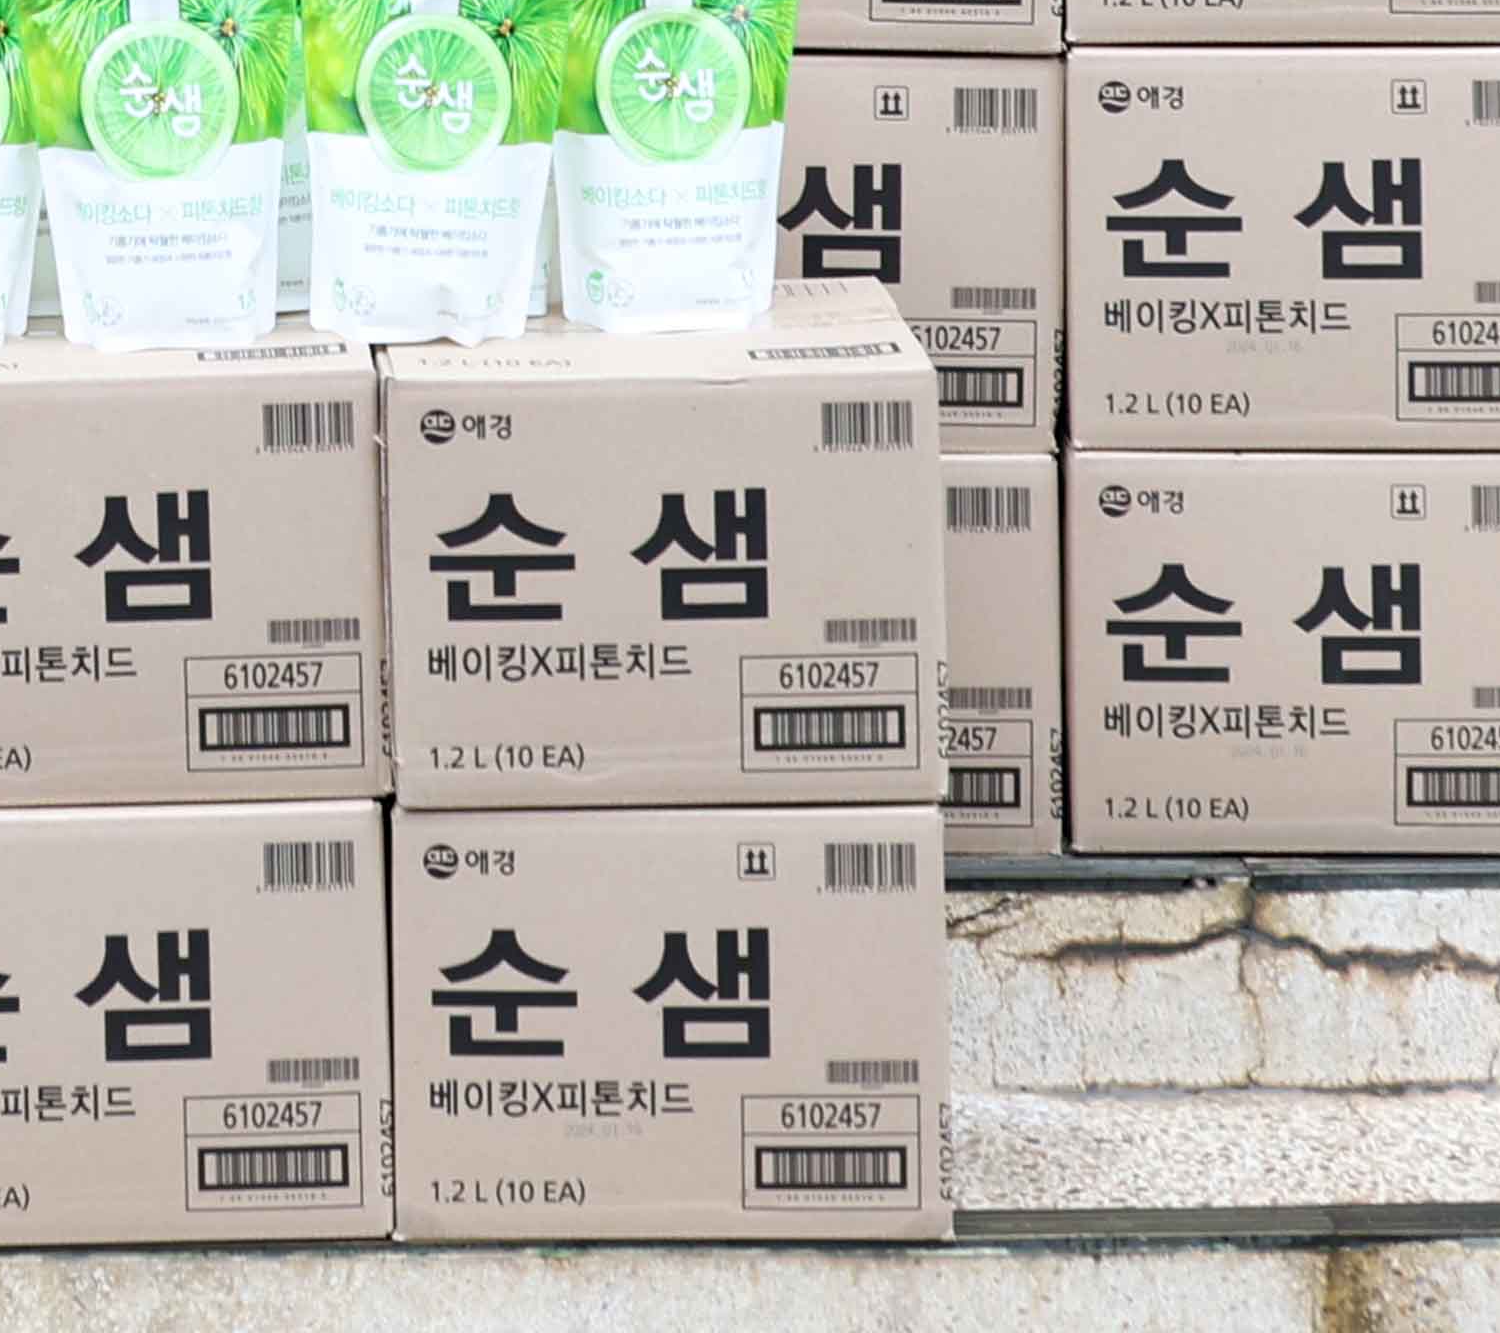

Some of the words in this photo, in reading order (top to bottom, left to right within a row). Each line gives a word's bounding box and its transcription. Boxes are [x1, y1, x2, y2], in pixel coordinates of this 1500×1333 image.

[1137, 83, 1186, 112] 애경
[1104, 296, 1352, 337] 베이킹X피톤치드
[462, 410, 514, 443] 애경
[428, 638, 693, 687] 베이킹X피톤치드
[1104, 701, 1350, 742] 베이킹X피톤치드
[220, 1096, 324, 1131] 6102457
[429, 1077, 694, 1120] 베이킹X피톤치드
[778, 1098, 882, 1131] 6102457
